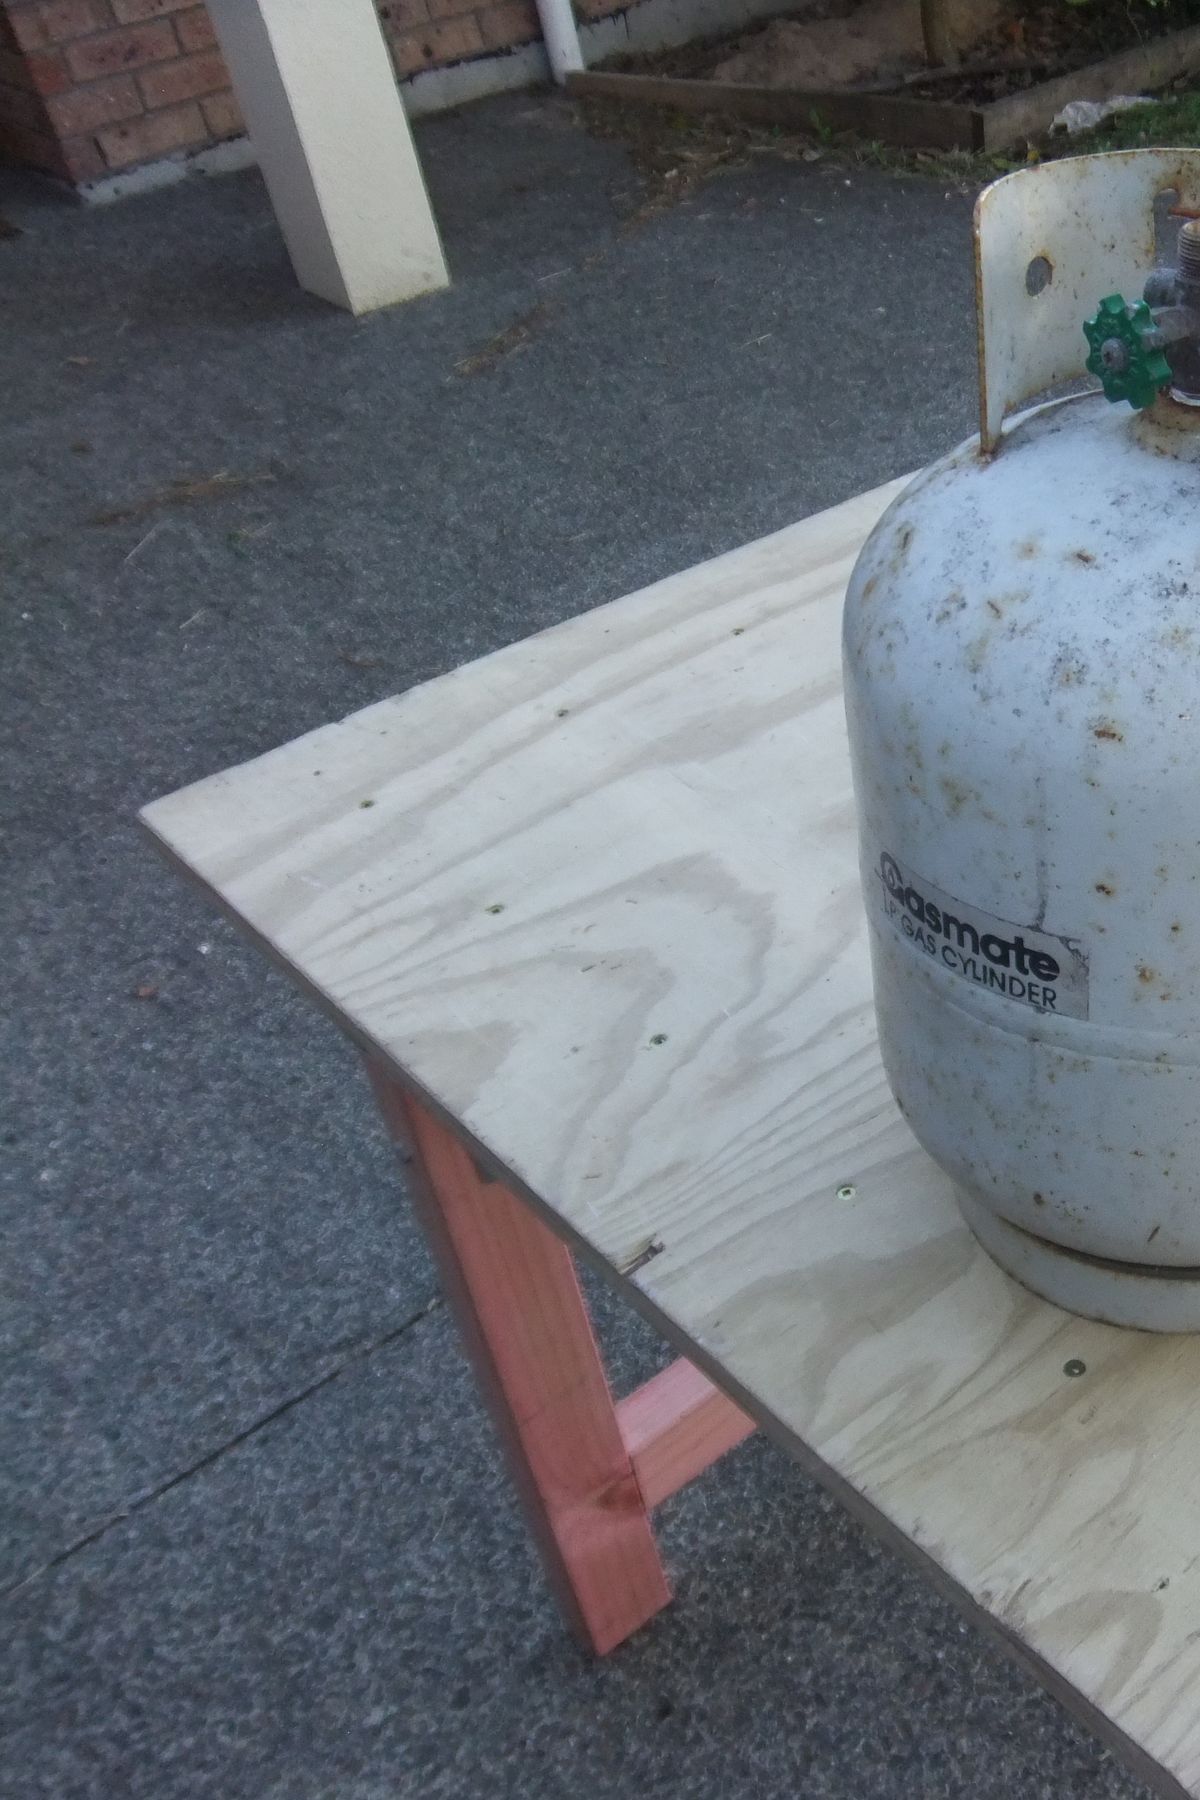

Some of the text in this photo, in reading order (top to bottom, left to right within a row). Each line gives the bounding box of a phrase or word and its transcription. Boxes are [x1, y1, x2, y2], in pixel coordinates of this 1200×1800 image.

[874, 851, 1060, 982] Gasmate
[901, 914, 937, 955] GAS
[941, 945, 1057, 1010] CYLINDER
